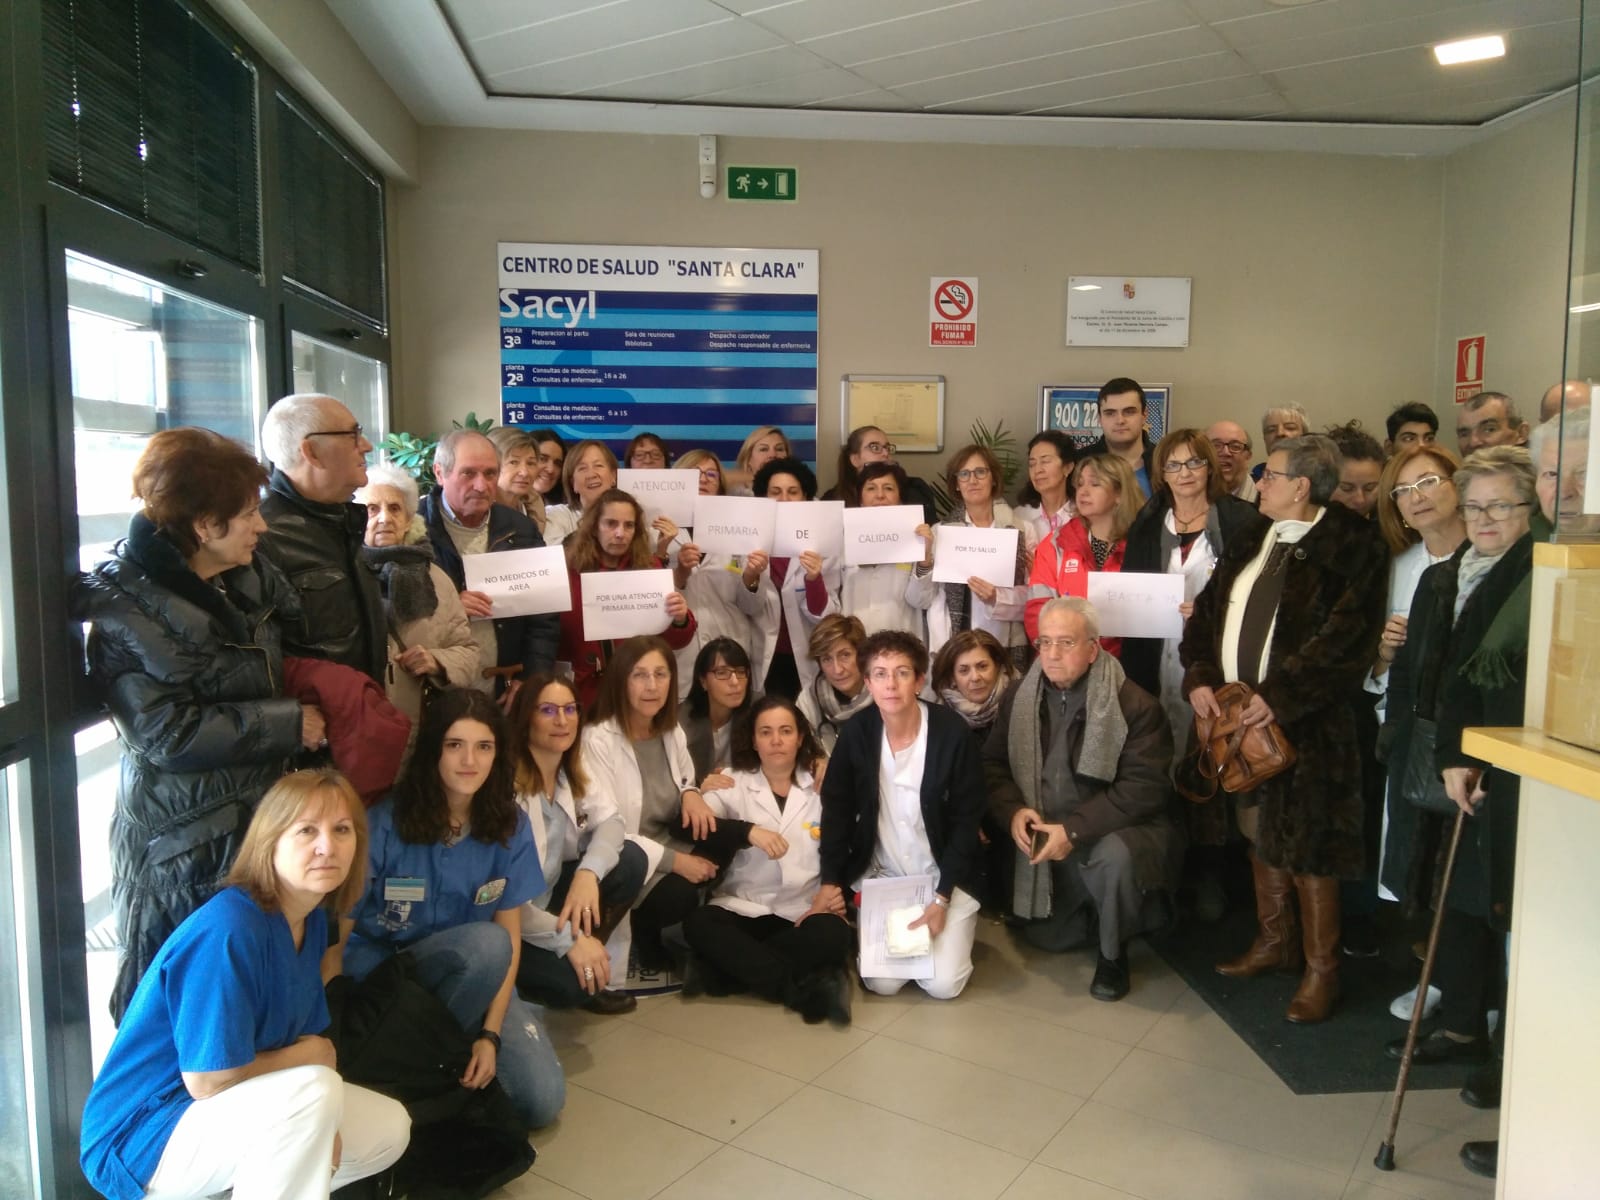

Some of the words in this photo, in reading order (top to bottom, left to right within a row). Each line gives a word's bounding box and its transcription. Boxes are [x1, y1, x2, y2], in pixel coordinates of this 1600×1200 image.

[503, 257, 573, 273] CENTRO
[577, 258, 599, 274] DE
[602, 259, 659, 275] SALUD
[668, 259, 735, 277] "SANTA
[741, 261, 804, 279] CLARA"
[499, 288, 596, 328] Sacyl
[935, 323, 971, 332] PROHIBIDO
[941, 331, 965, 340] FUMAR
[505, 364, 525, 372] planta
[506, 402, 526, 410] planta
[1055, 402, 1080, 428] 900
[632, 480, 686, 491] ATENCION
[707, 525, 760, 537] PRIMARIA
[796, 529, 809, 540] DE
[858, 533, 899, 544] CALIDAD
[484, 576, 498, 584] NO
[499, 570, 537, 582] MEDICOS
[538, 568, 550, 577] DE
[508, 582, 531, 592] AREA
[595, 594, 611, 602] POR
[611, 593, 628, 601] UNA
[629, 591, 663, 600] ATENCION
[601, 604, 636, 612] PRIMARIA
[636, 602, 659, 610] DIGNA
